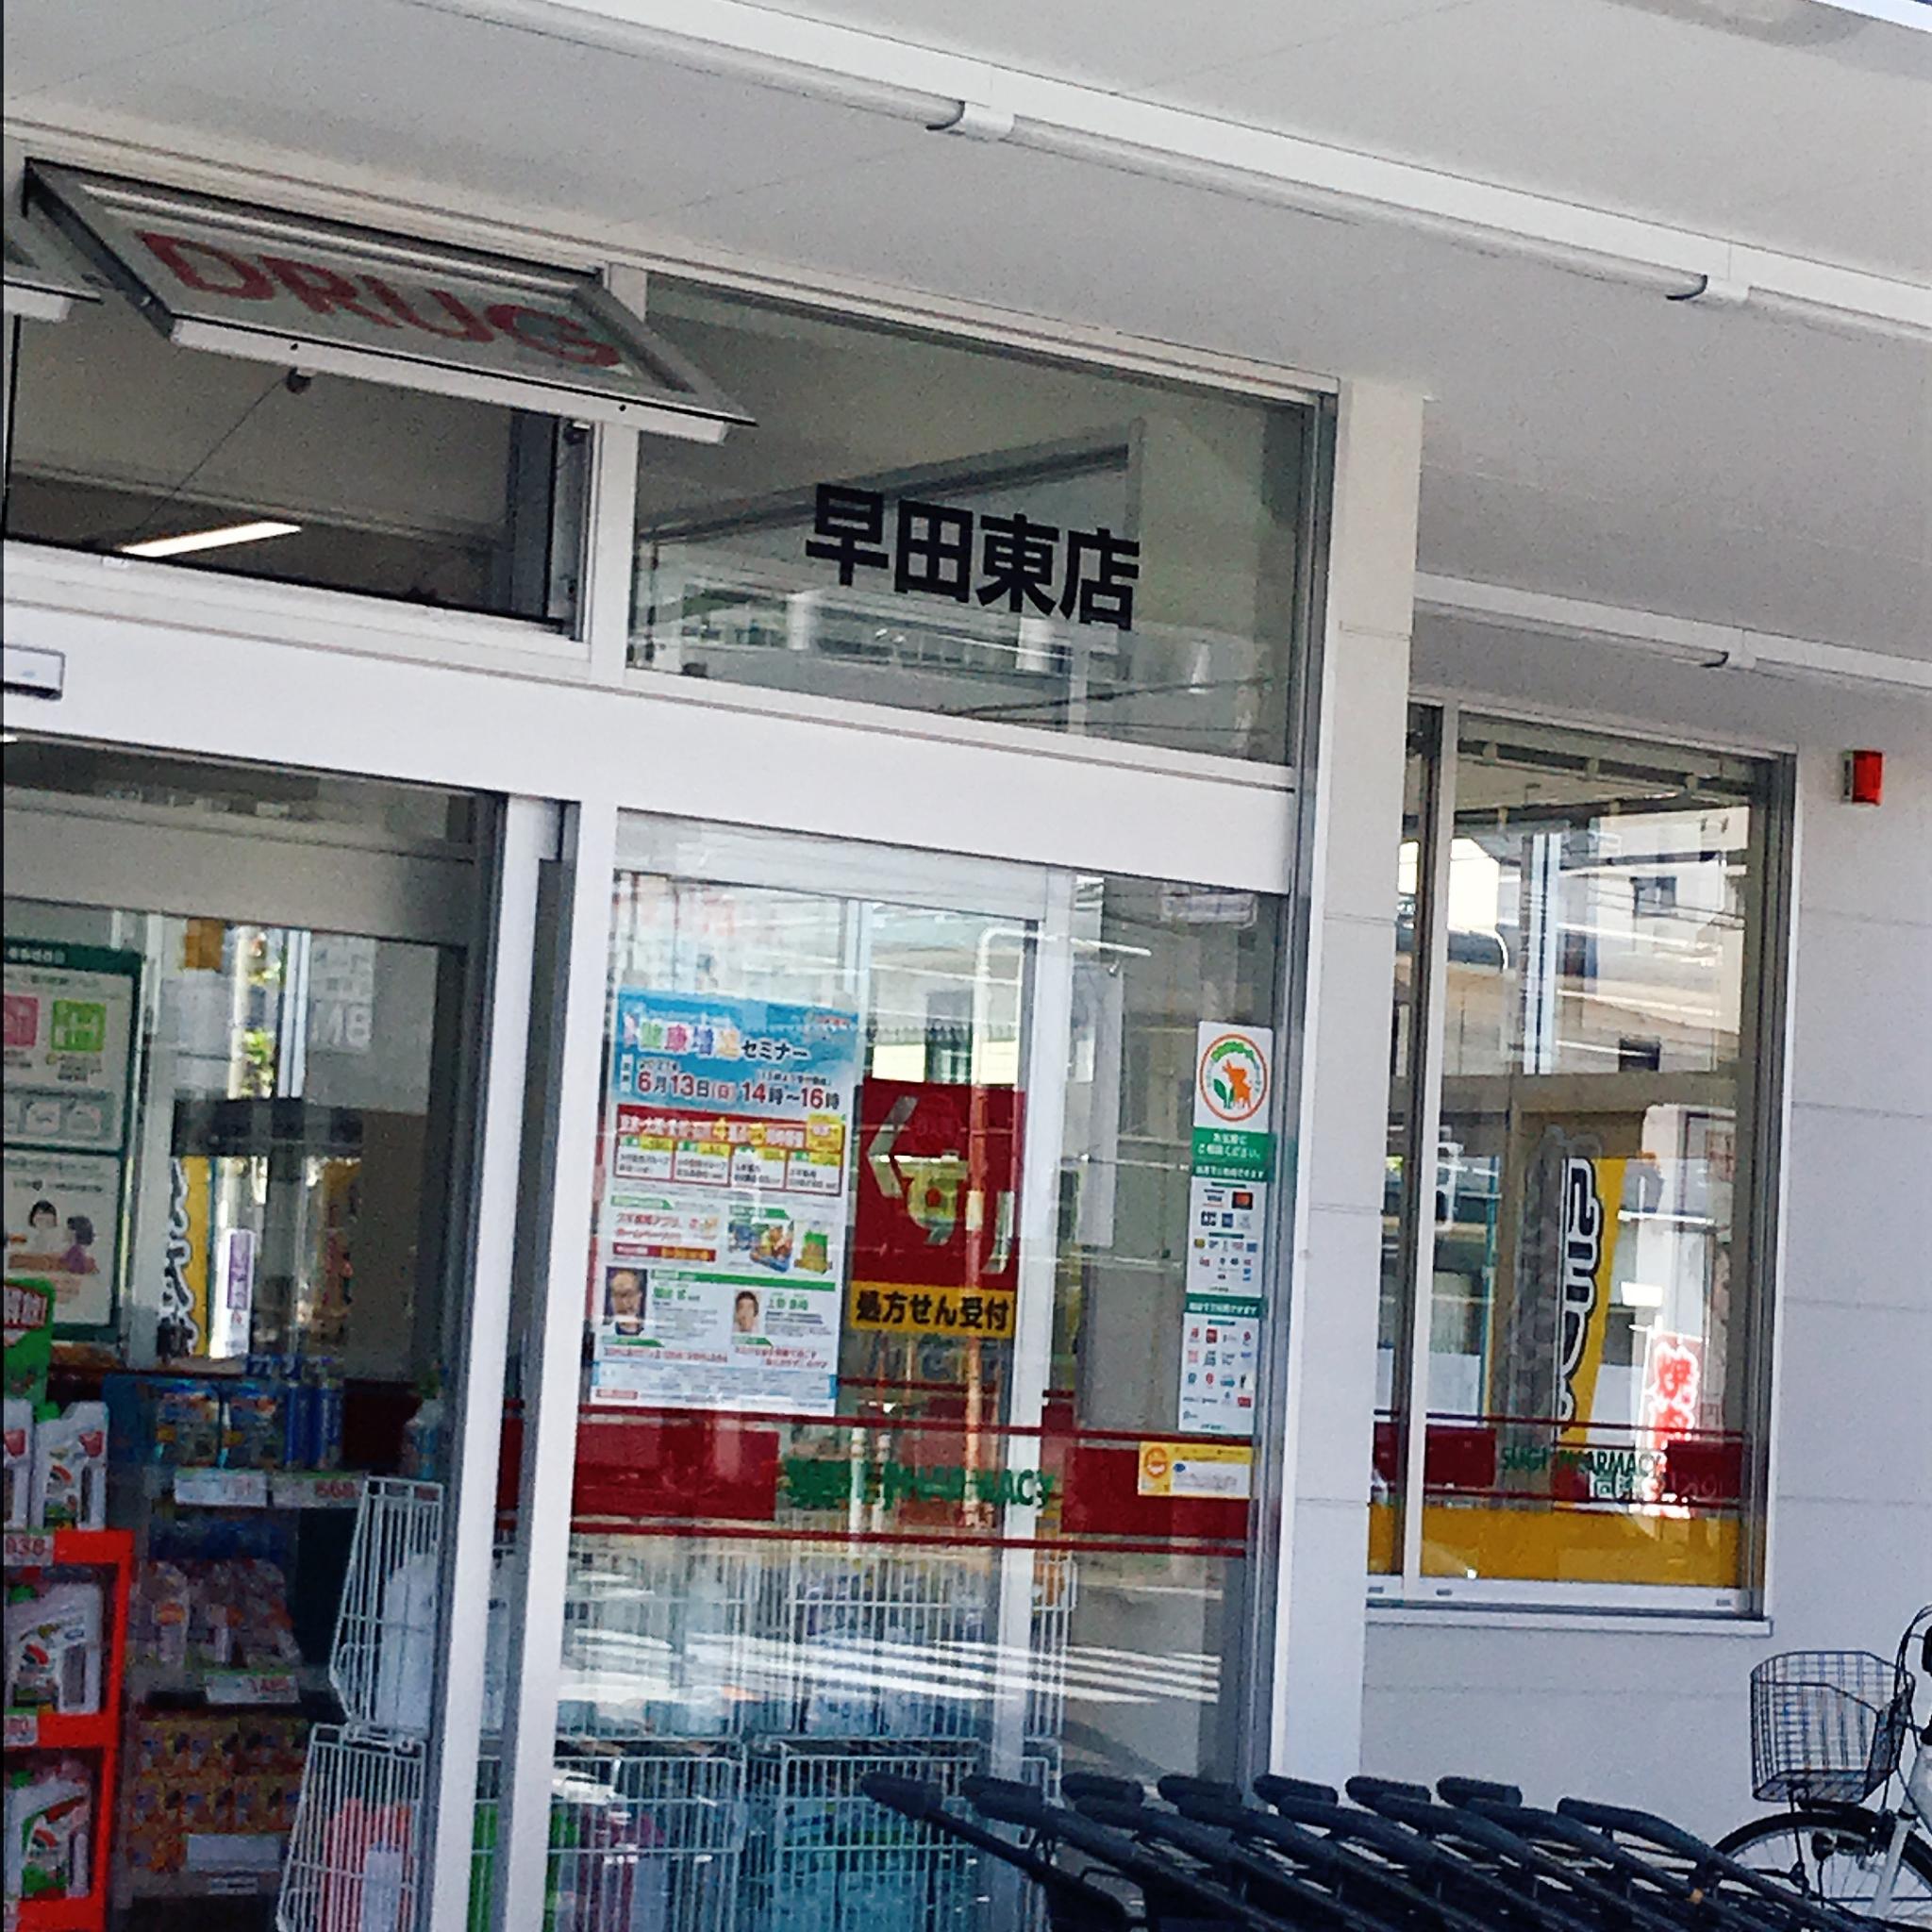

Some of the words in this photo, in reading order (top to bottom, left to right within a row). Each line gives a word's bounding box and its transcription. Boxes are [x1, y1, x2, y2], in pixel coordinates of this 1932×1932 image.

[135, 230, 623, 368] DRUG
[806, 483, 1140, 631] 早田東店
[856, 1290, 1010, 1331] 処方せん受付
